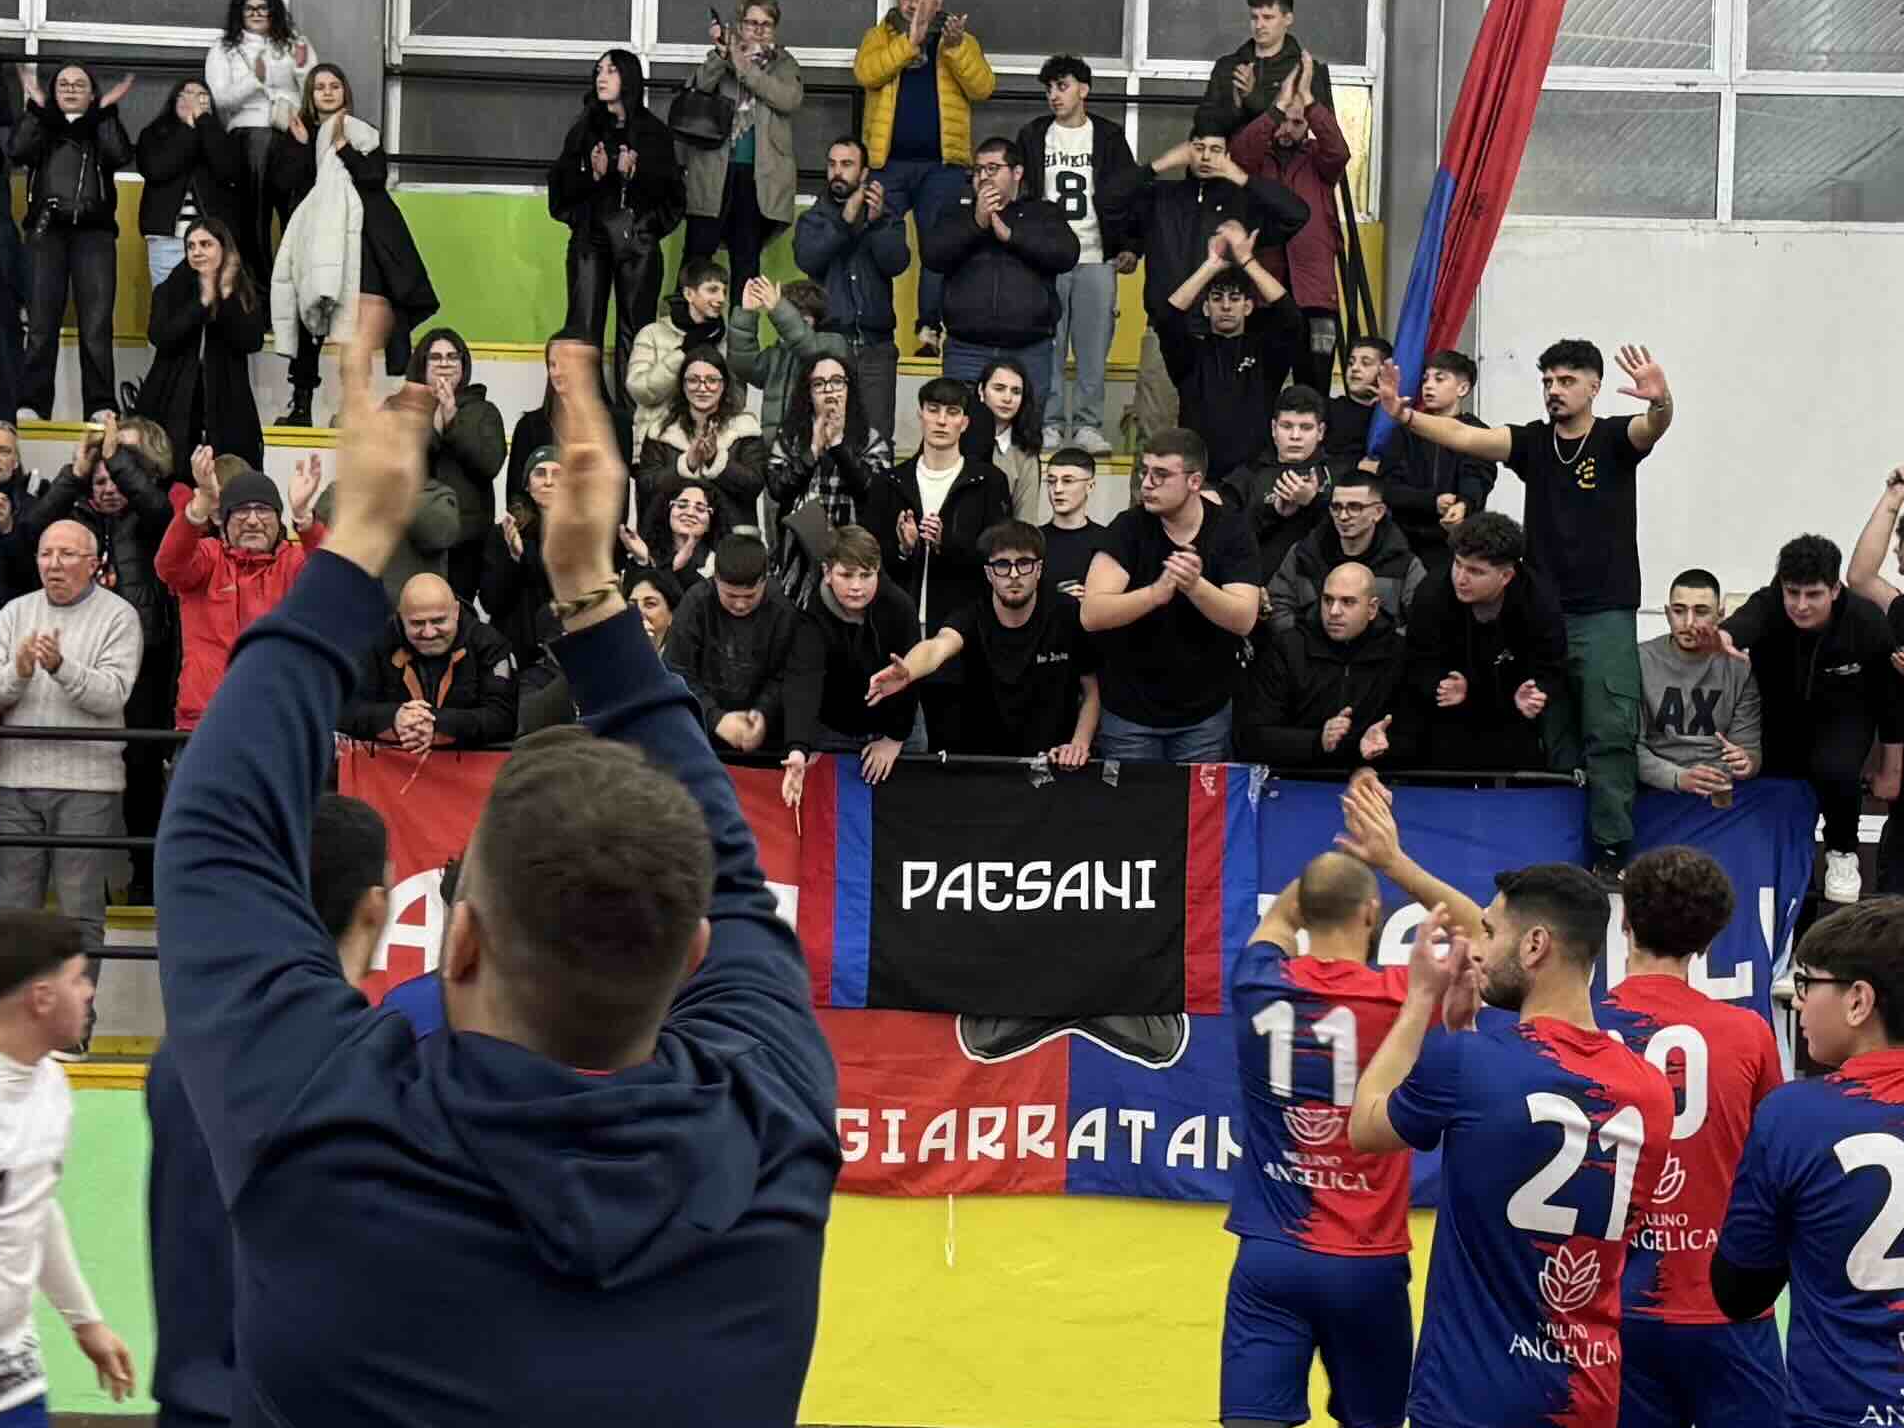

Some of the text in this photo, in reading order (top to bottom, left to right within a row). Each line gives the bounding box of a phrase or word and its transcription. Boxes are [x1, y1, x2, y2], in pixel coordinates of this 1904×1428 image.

[1646, 686, 1724, 735] AX
[902, 859, 1157, 911] PAESANI
[1251, 999, 1358, 1107] 11
[1607, 1023, 1709, 1140] 0
[835, 1104, 1244, 1171] GIARRATAN
[1506, 1091, 1644, 1242] 21
[1630, 1228, 1719, 1253] NGELICA
[1640, 1213, 1689, 1227] ULINO
